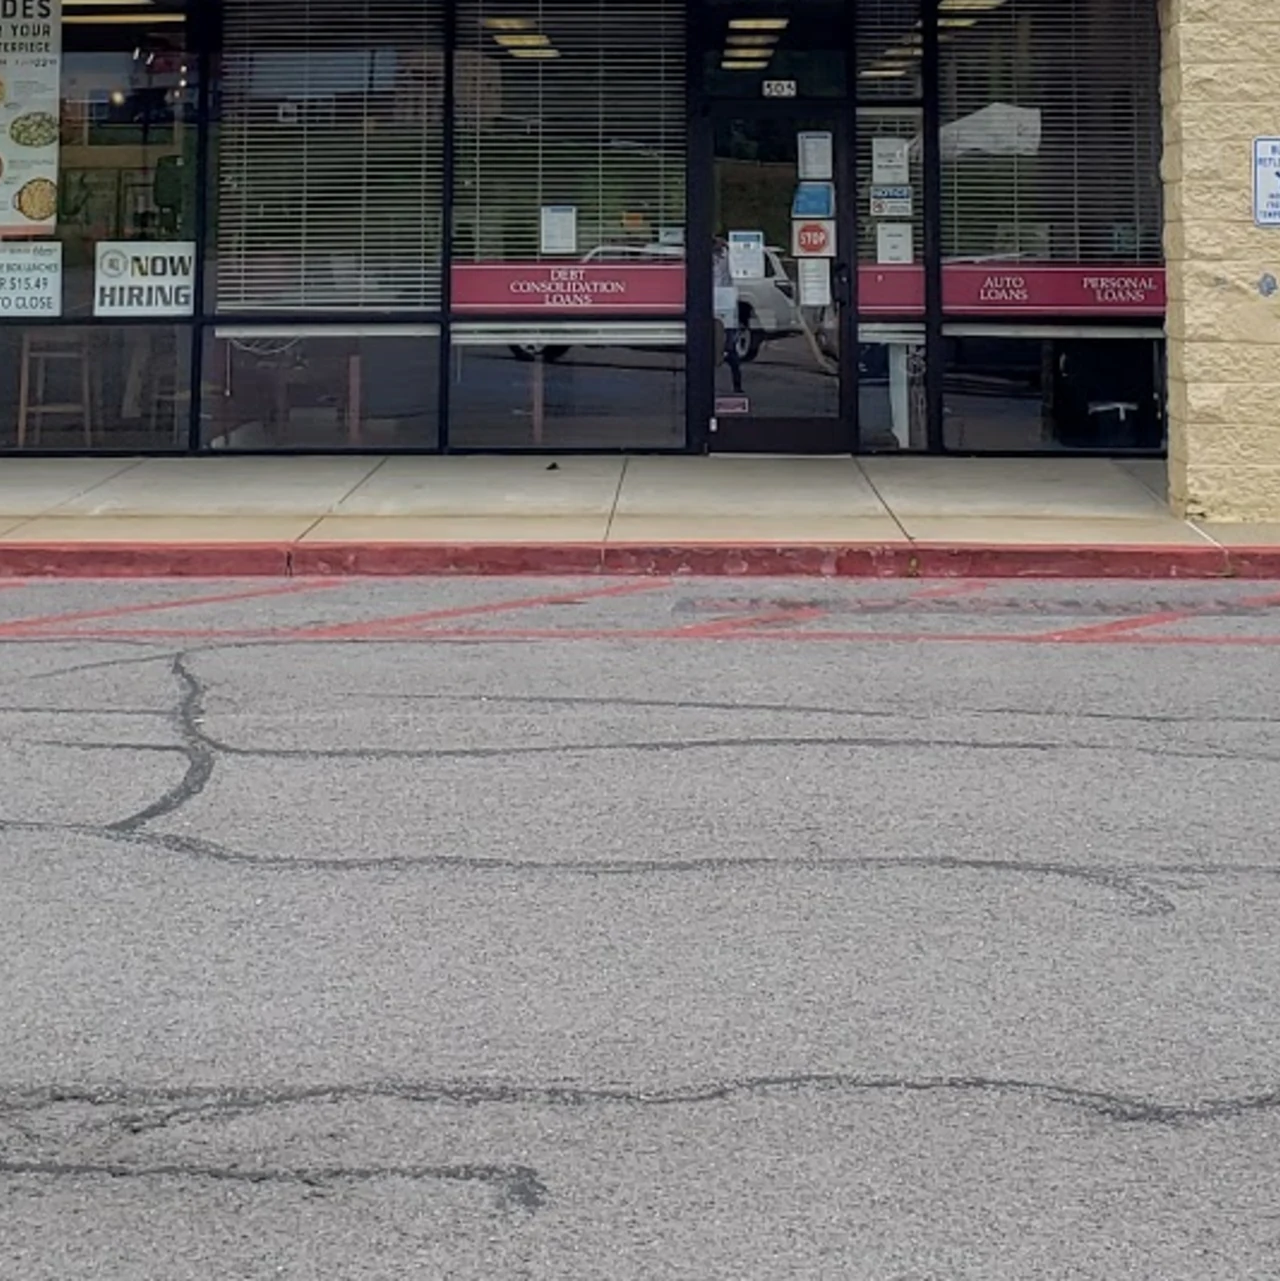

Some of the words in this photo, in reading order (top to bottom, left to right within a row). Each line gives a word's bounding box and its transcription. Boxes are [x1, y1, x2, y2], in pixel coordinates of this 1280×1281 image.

[10, 23, 51, 37] YOUR
[800, 232, 826, 245] STOP
[130, 255, 192, 277] NOW
[550, 269, 586, 281] DEBT
[509, 281, 627, 294] CONSOLIDATION
[982, 277, 1025, 289] AUTO
[1082, 277, 1158, 289] PERSONAL
[99, 286, 191, 307] HIRING
[543, 293, 593, 305] LOANS
[979, 288, 1029, 301] LOANS
[1095, 289, 1145, 302] LOANS
[15, 296, 54, 310] CLOSE
